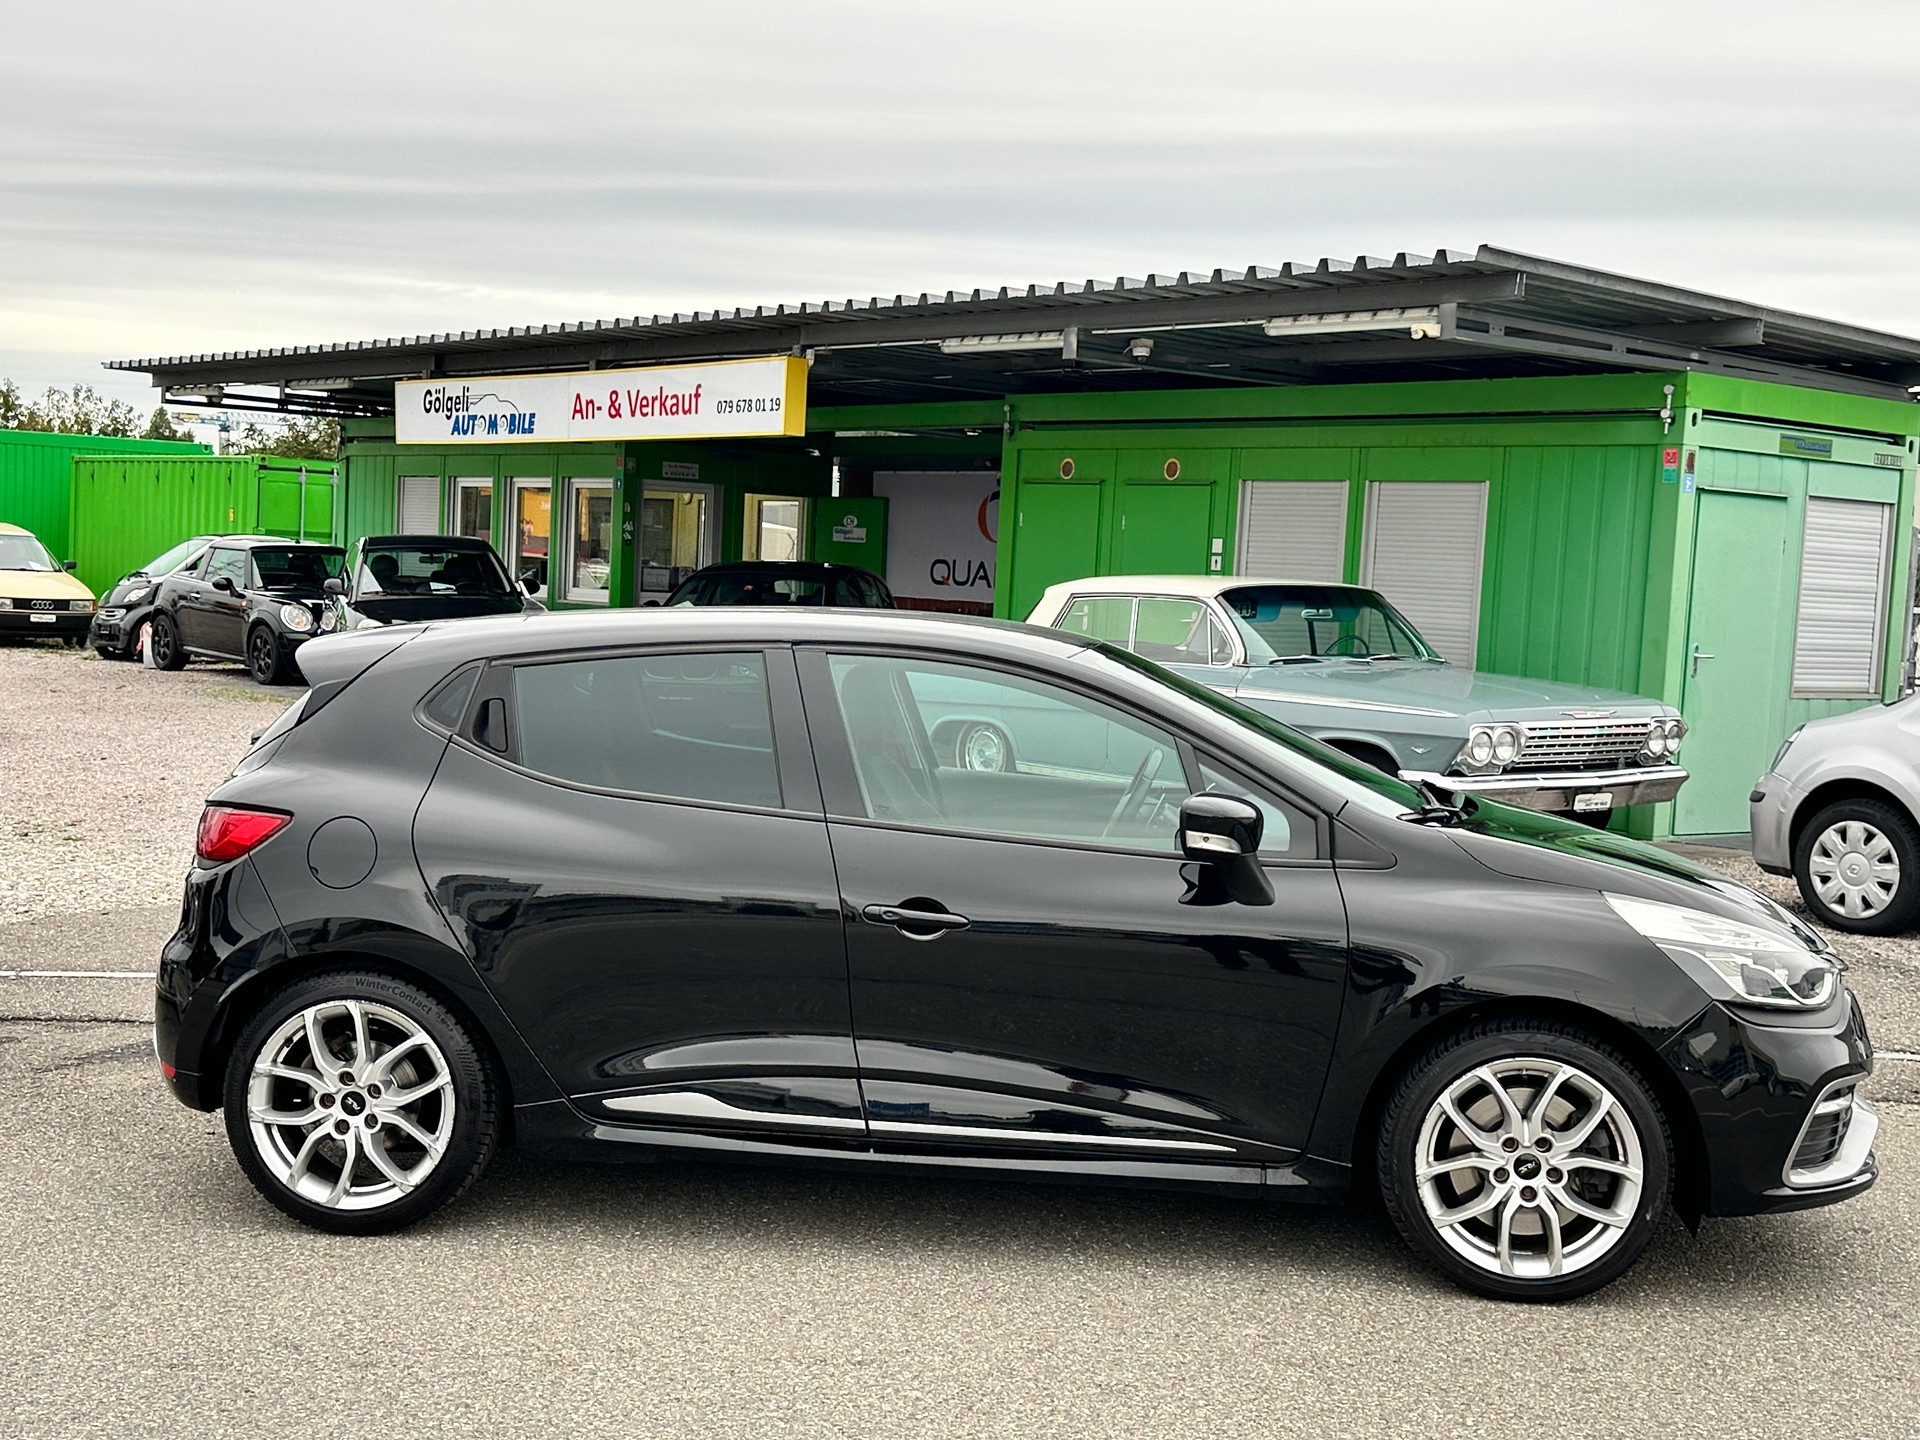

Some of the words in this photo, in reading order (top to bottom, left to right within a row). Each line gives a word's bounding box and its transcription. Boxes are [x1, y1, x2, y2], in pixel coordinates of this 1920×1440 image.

[423, 386, 470, 420] Gölgeli
[572, 393, 602, 420] An-
[607, 389, 622, 419] &
[627, 384, 702, 418] Verkauf
[716, 399, 734, 414] 079
[735, 398, 753, 413] 678
[754, 397, 767, 412] 01
[769, 397, 781, 411] 19
[451, 412, 536, 436] AUTOMOBILE
[355, 977, 431, 1015] WinterContact
